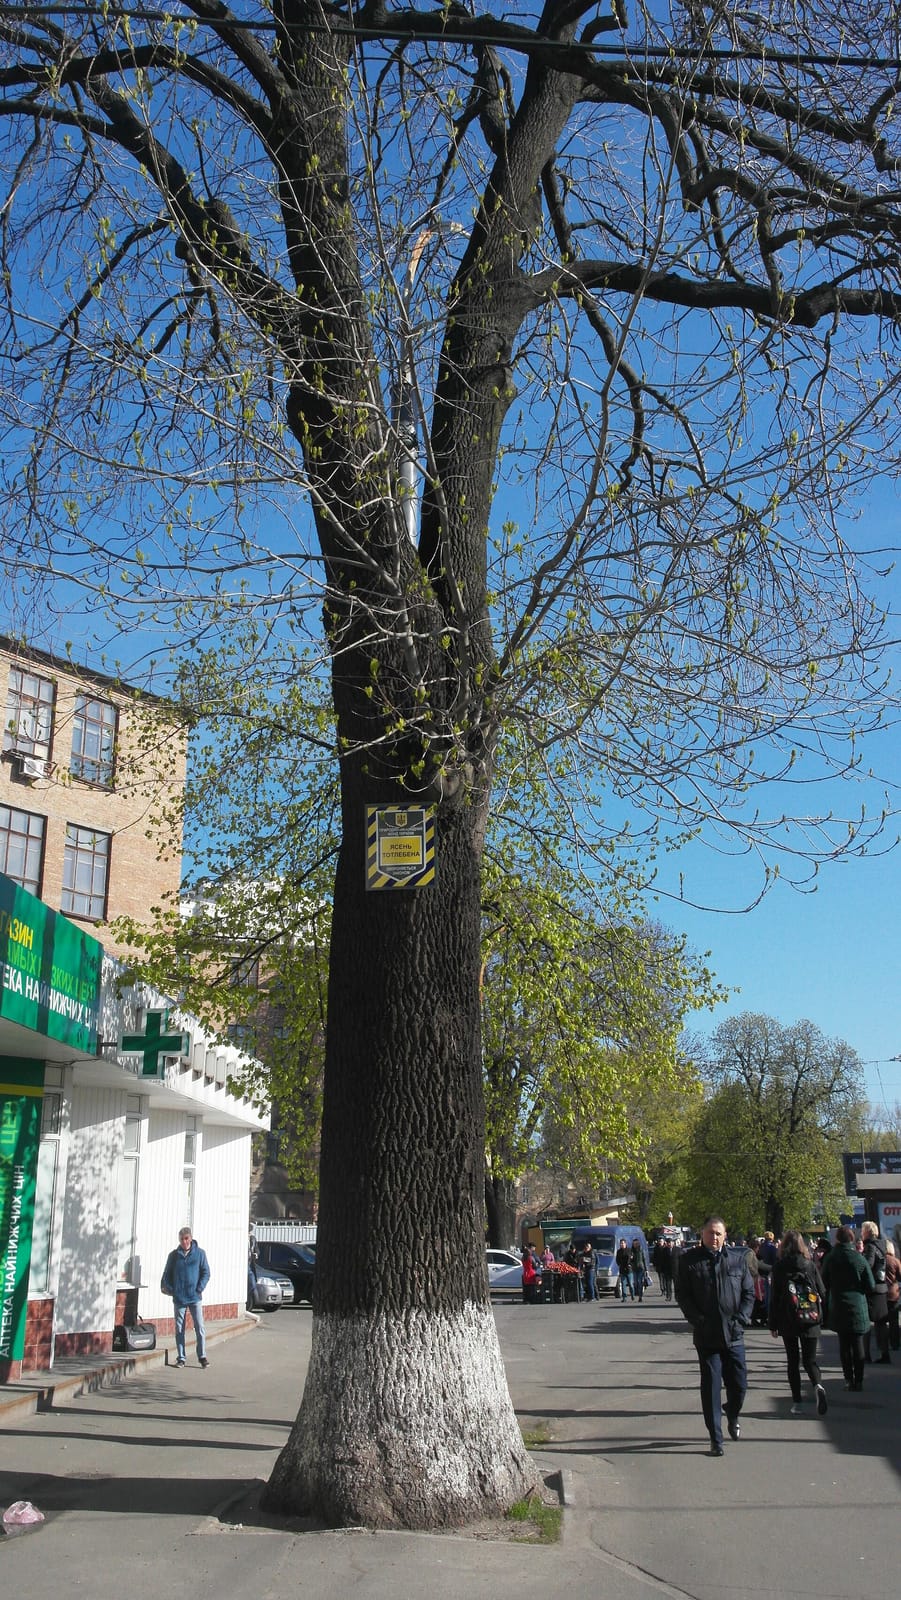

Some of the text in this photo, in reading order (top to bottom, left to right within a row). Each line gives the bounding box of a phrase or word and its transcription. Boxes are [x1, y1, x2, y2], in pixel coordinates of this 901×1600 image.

[25, 975, 83, 1024] НАЙНИЖЧИХ
[13, 1165, 25, 1190] ЦІН
[4, 1195, 23, 1293] НАЙНИЖЧИХ
[0, 1296, 14, 1358] АПТЕКА
